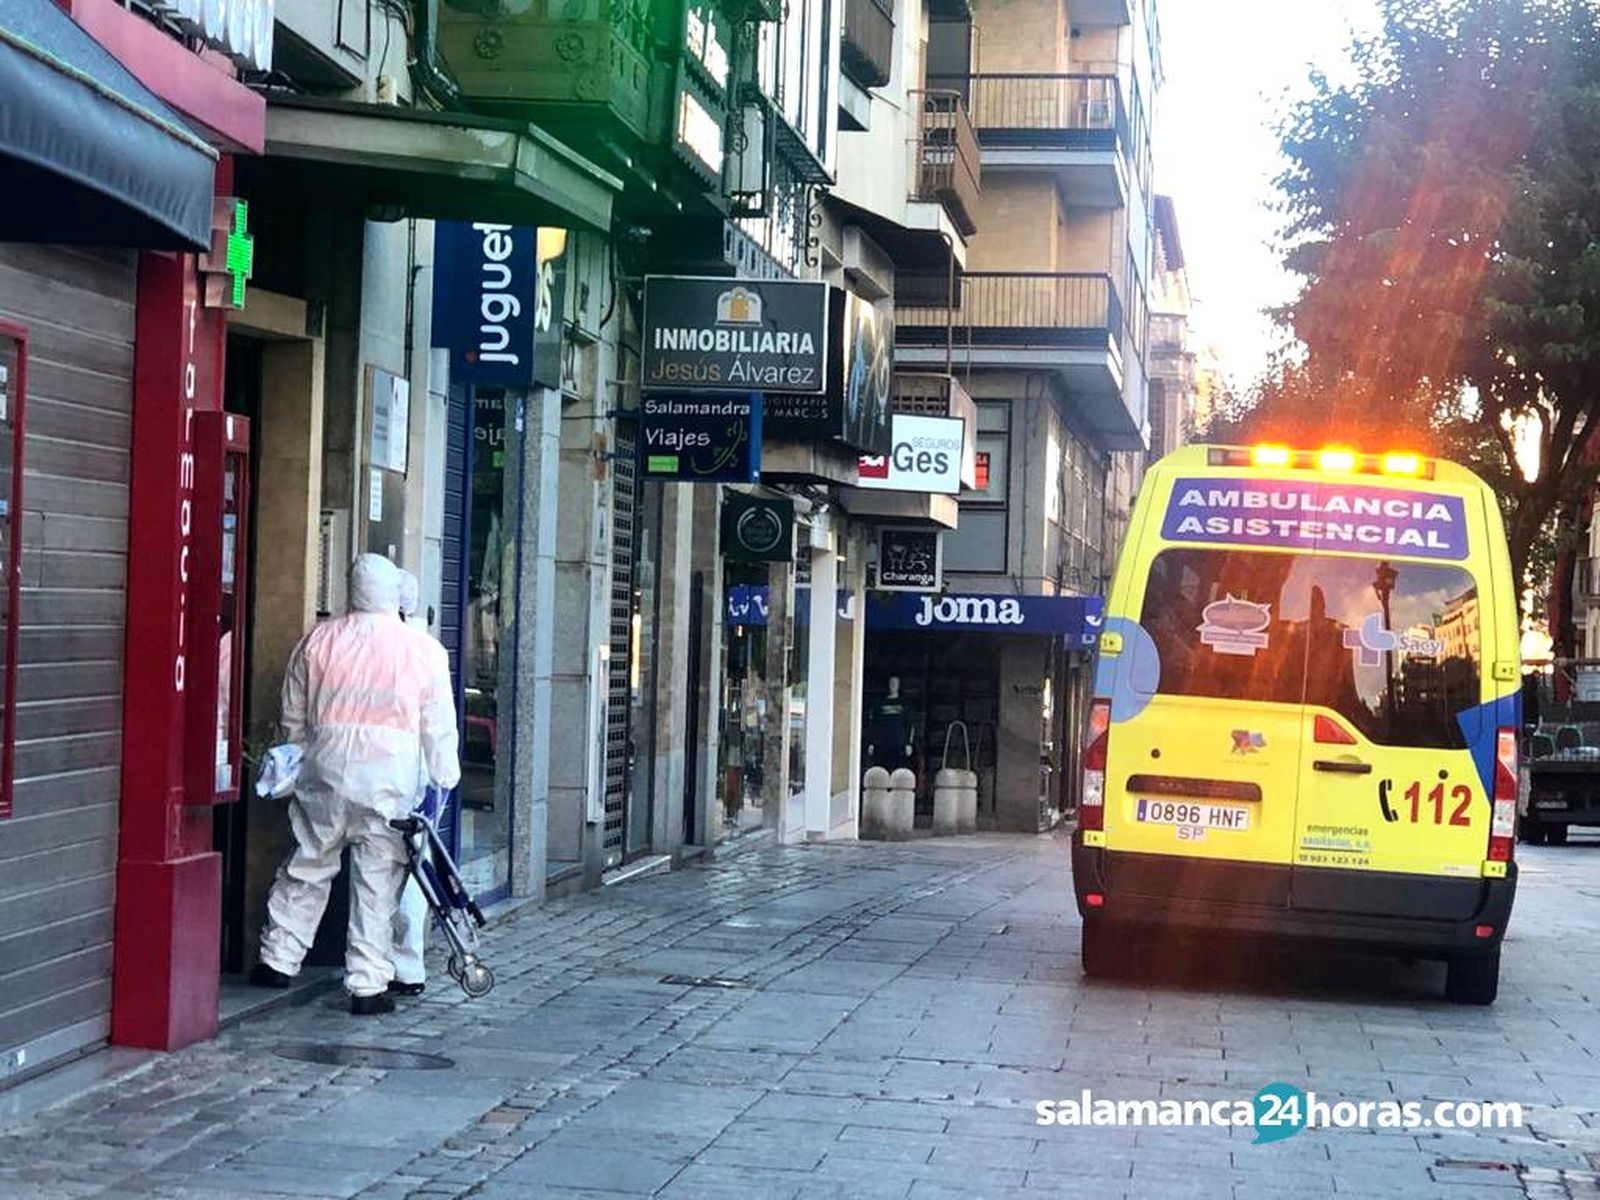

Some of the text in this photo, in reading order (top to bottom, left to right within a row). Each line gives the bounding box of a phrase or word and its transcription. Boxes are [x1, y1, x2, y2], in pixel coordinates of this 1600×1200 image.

[655, 328, 815, 354] INMOBILIARIA
[652, 354, 815, 384] Jesús Álvarez
[645, 400, 750, 416] Salamandra
[646, 428, 711, 450] Viajes
[893, 442, 949, 474] Ges
[175, 300, 197, 691] farmacia
[1178, 489, 1453, 522] AMBULANCIA
[1177, 516, 1451, 549] ASISTENCIAL
[883, 571, 935, 585] Charanga
[1150, 803, 1247, 827] 0896 HNF
[1404, 781, 1472, 827] 112
[1178, 827, 1204, 840] SP
[1307, 825, 1369, 837] emergencias
